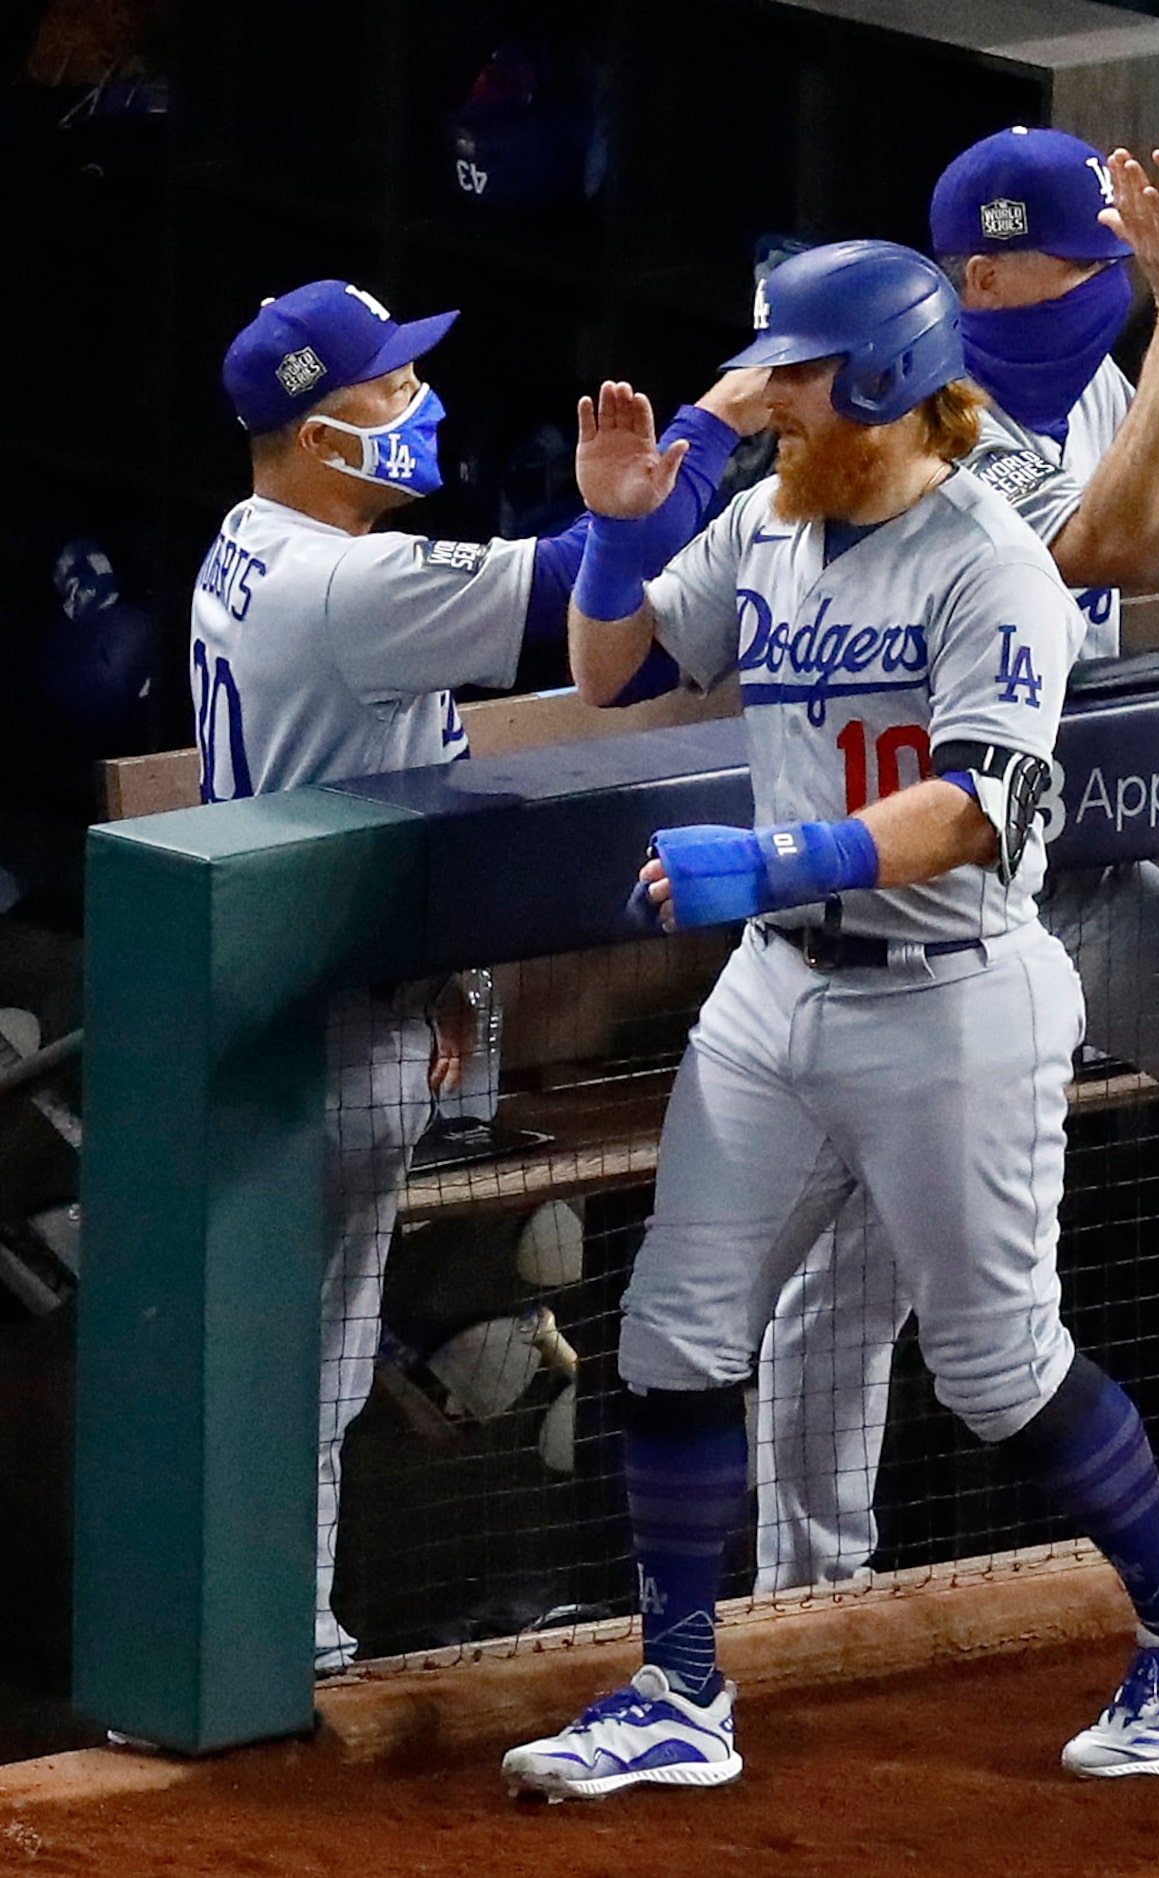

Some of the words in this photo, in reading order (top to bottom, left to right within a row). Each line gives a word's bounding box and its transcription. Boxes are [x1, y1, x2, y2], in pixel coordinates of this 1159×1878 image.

[456, 159, 488, 194] 43
[984, 206, 1022, 222] WORLD
[984, 218, 1023, 233] SERIES
[386, 433, 416, 478] LA
[736, 588, 929, 728] Dodgers
[995, 624, 1042, 709] LA
[772, 832, 797, 857] 10
